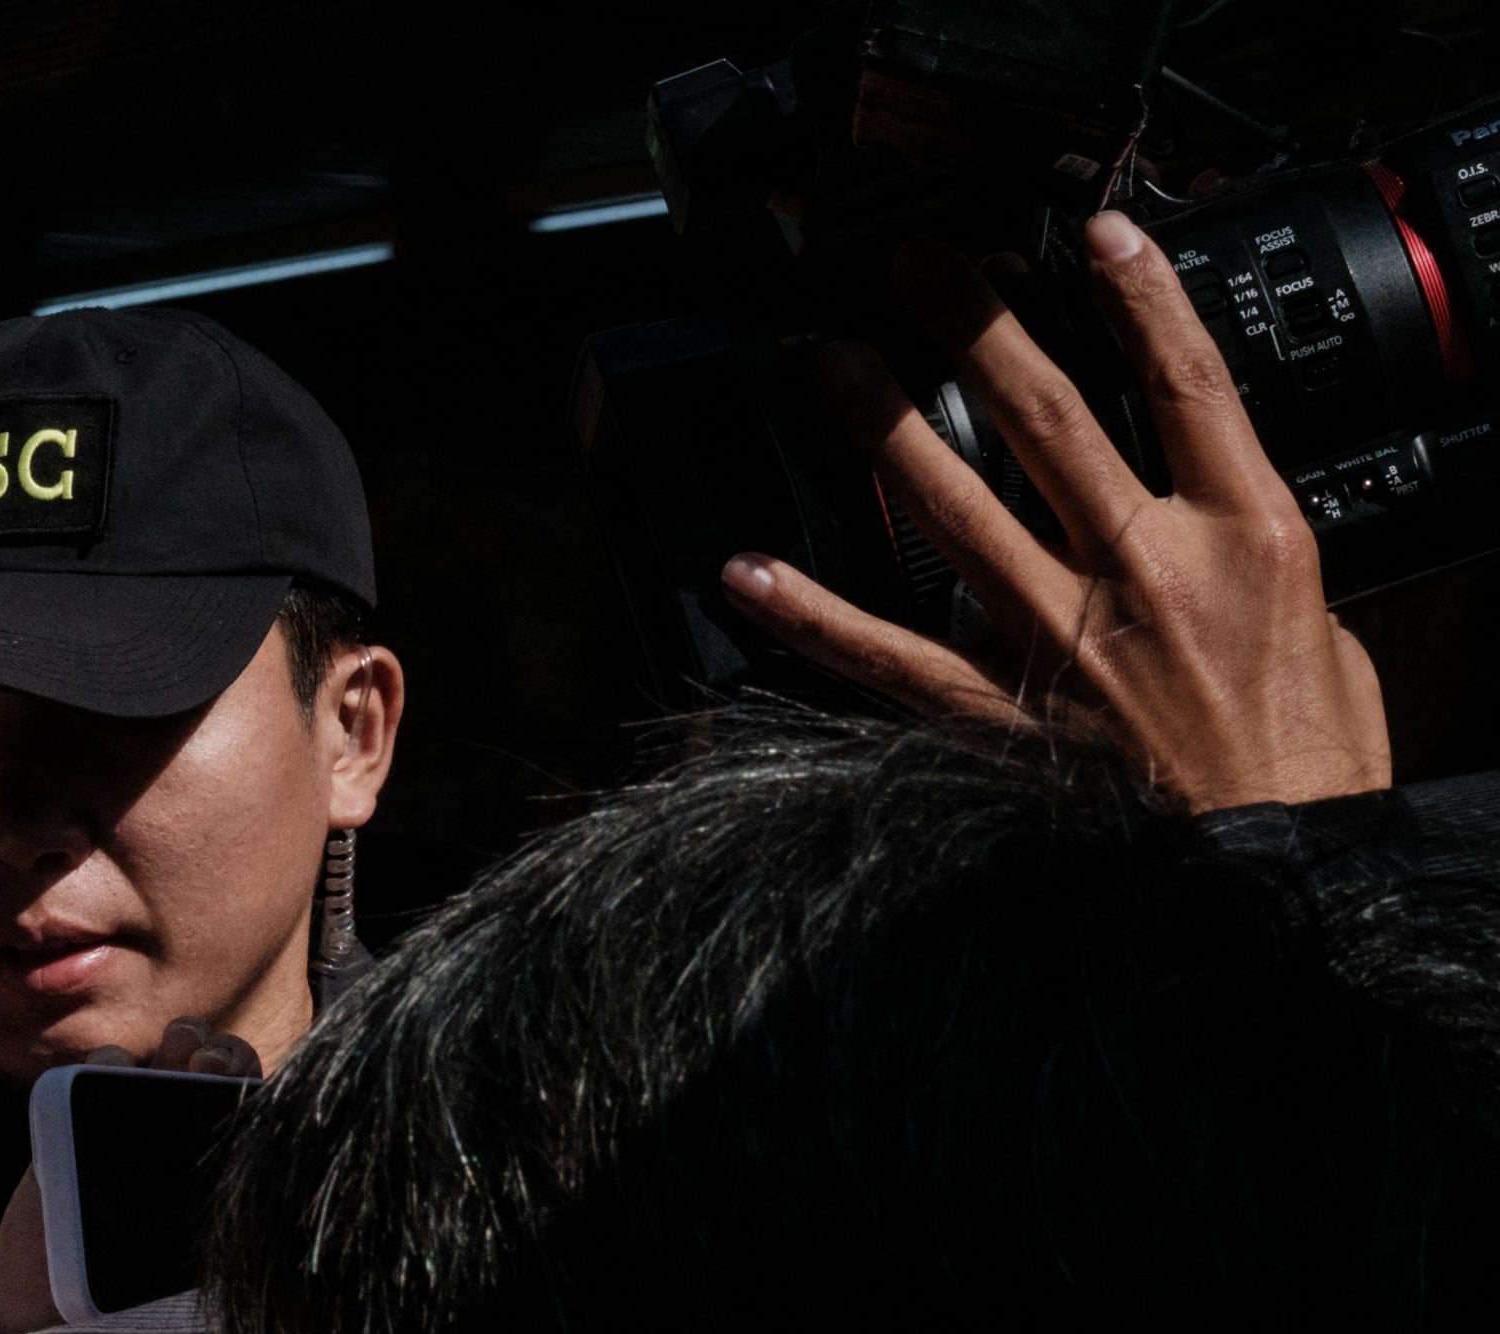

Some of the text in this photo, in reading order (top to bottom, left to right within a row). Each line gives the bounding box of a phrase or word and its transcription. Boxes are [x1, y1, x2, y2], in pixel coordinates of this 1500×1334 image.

[1457, 162, 1489, 180] O.I.S.
[1469, 209, 1500, 228] ZEBR
[1255, 225, 1294, 246] FOCUS
[1260, 233, 1298, 254] ASSIST
[1174, 254, 1211, 273] FILTER
[1178, 249, 1197, 262] ND
[1227, 271, 1253, 288] 1/64
[1275, 276, 1315, 298] FOCUS
[1234, 288, 1259, 304] 1/16
[1240, 305, 1259, 320] 1/4
[1245, 322, 1269, 337] CLR
[1290, 335, 1343, 361] PUSH AUTO
[1439, 422, 1492, 448] SHUTTER
[1335, 452, 1374, 471] WHITE
[1295, 468, 1326, 485] GAIN
